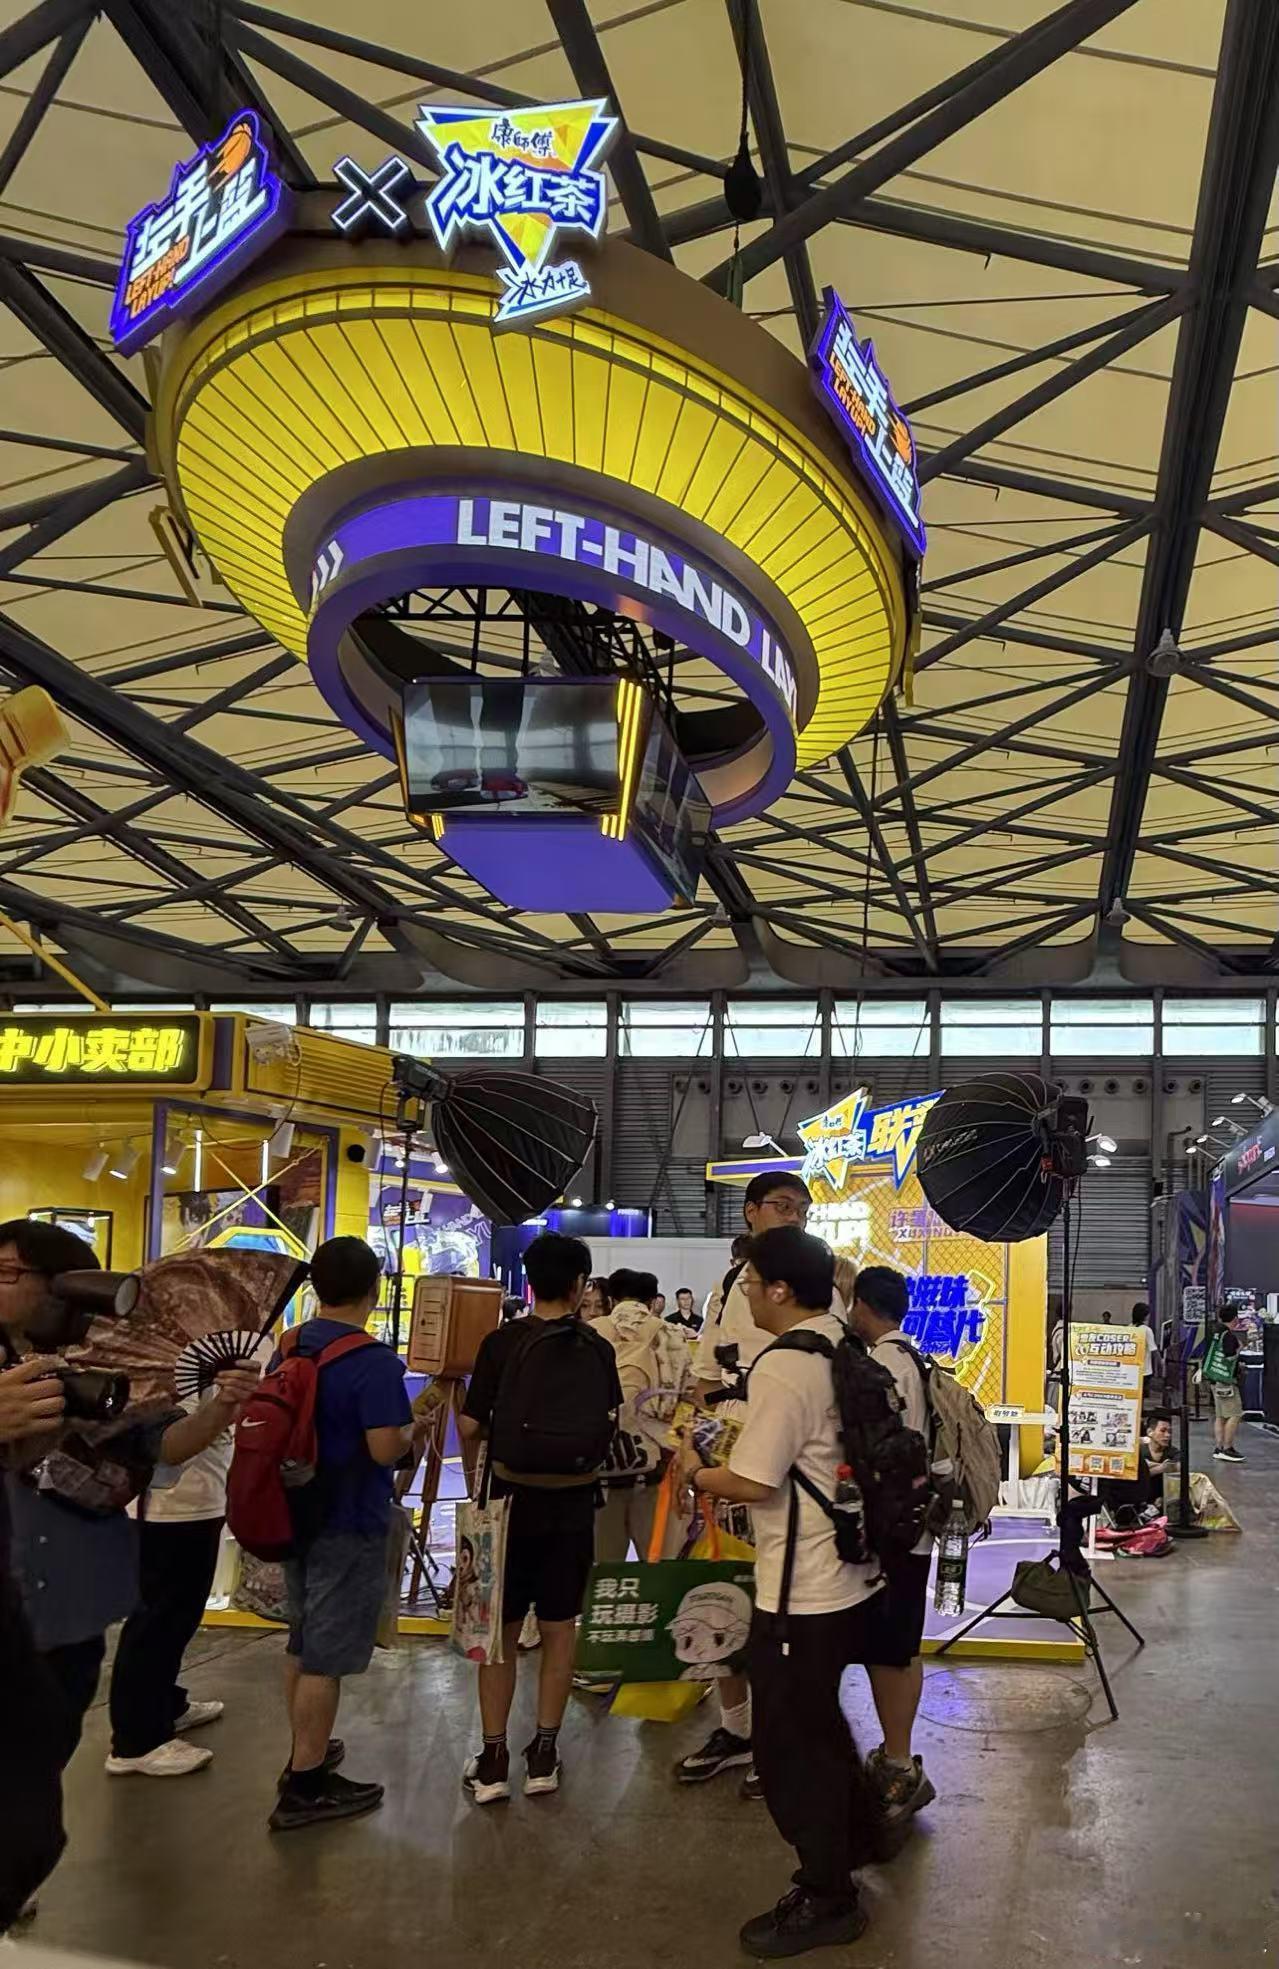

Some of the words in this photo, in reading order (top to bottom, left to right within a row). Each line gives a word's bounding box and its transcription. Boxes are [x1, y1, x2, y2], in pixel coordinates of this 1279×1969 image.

[437, 148, 595, 223] 冰红茶
[456, 498, 751, 648] LEFT-HAND
[594, 1577, 641, 1599] 我只
